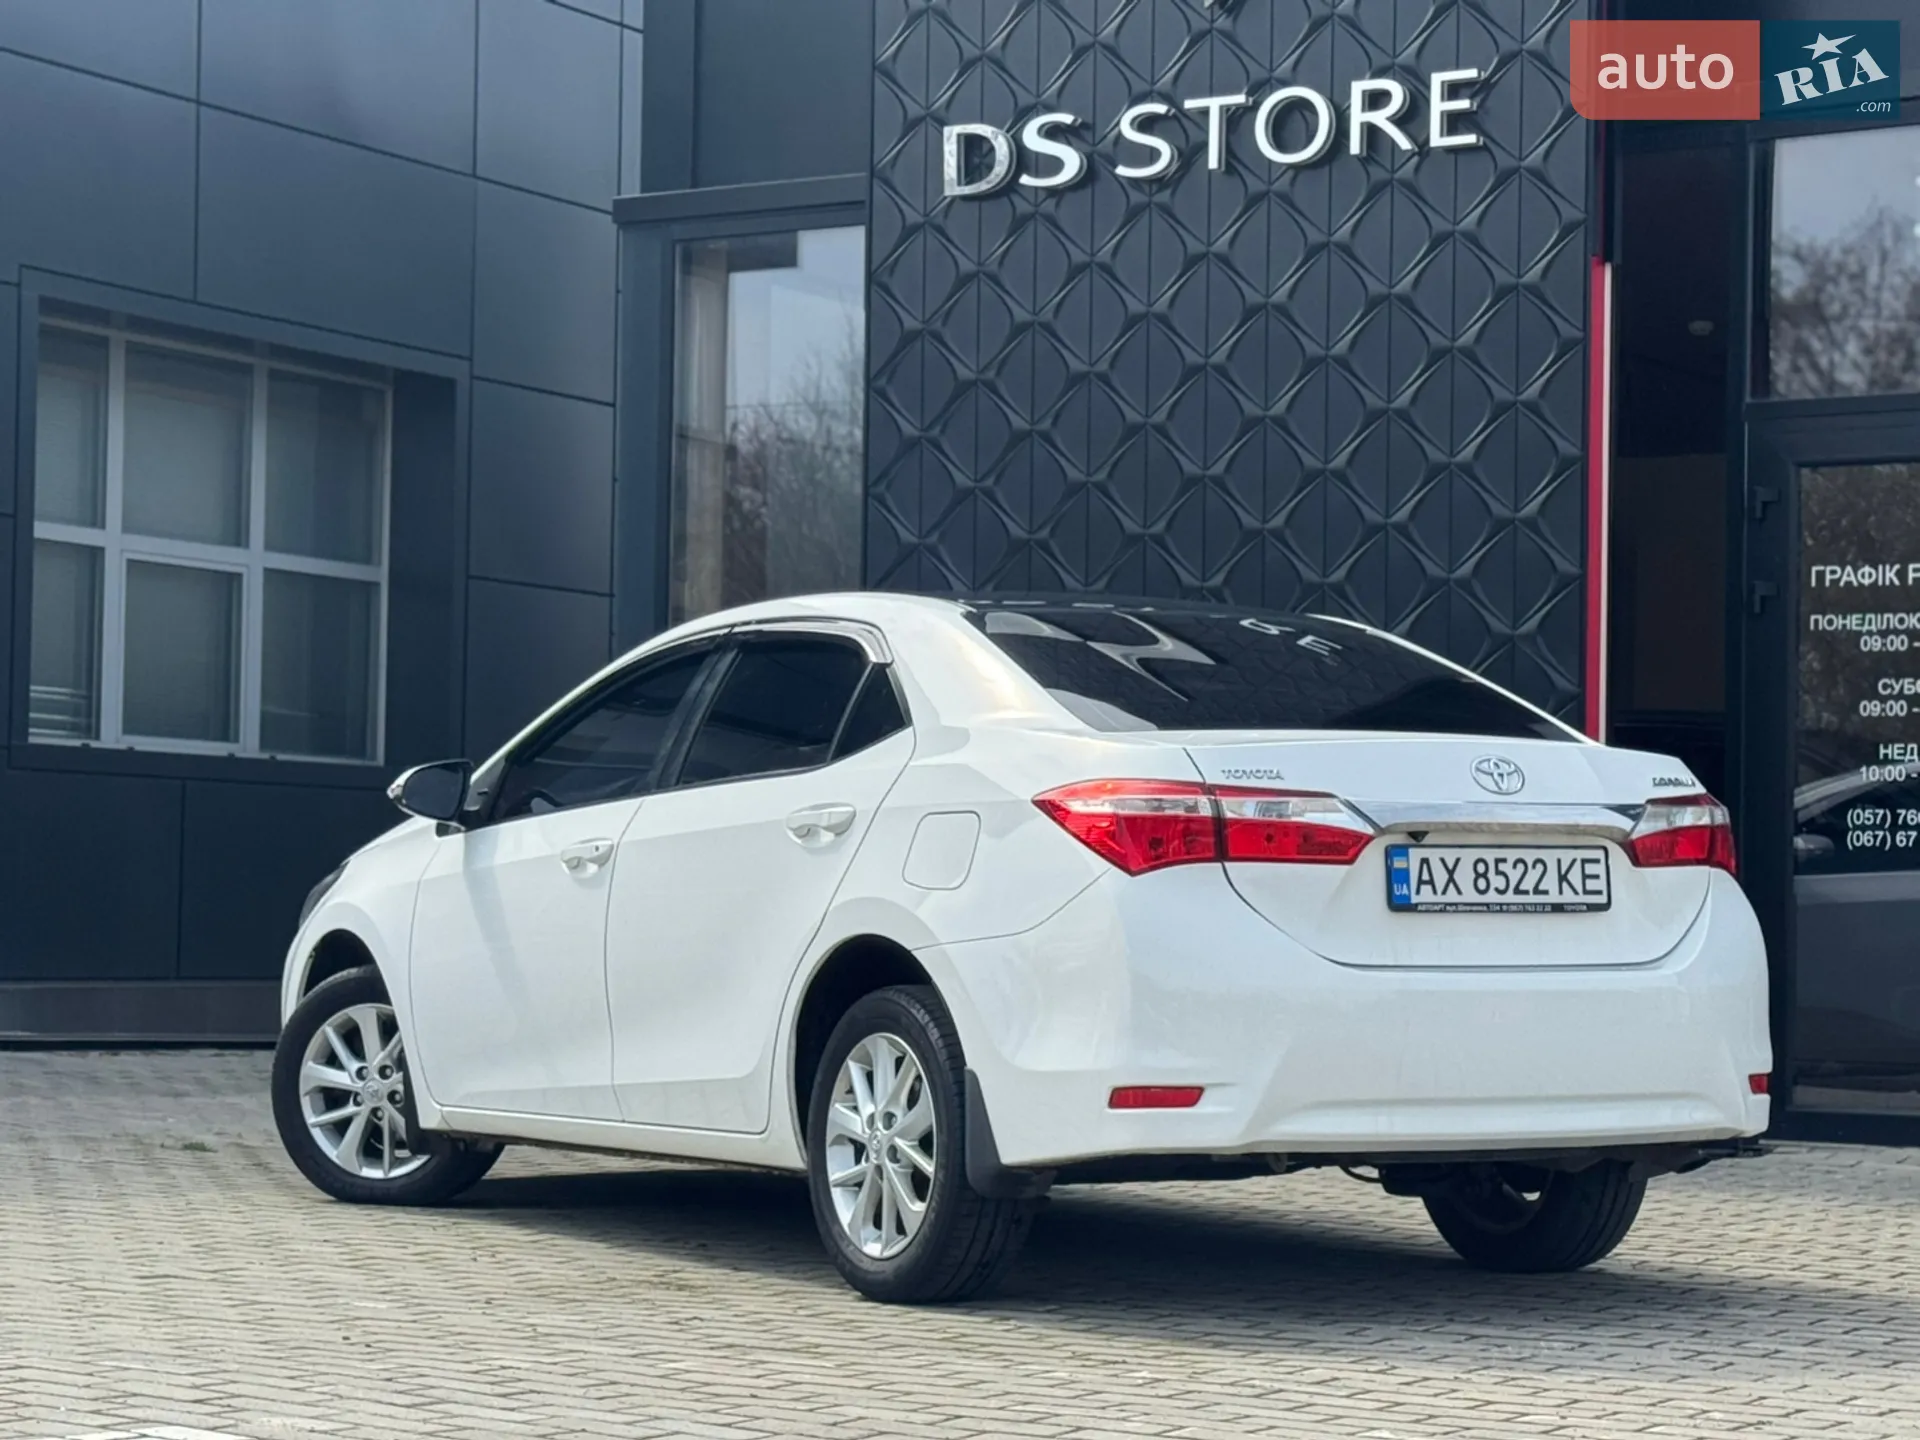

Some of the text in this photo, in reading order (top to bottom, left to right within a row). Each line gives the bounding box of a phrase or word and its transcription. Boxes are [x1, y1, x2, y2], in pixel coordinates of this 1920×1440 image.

[943, 68, 1485, 197] DS STORE
[1811, 564, 1901, 588] ГРАФІК
[1810, 612, 1920, 633] ПОНЕДІЛОК
[1860, 634, 1908, 652] 09:00
[1859, 700, 1908, 717] 09:00
[1879, 743, 1919, 762] НЕД
[1221, 769, 1285, 780] TOYOTA
[1859, 765, 1906, 782] 10:00
[1847, 808, 1891, 829] (057)
[1847, 830, 1918, 851] (067) 67
[1415, 857, 1603, 896] AX 8522 KE
[1394, 884, 1409, 896] UA
